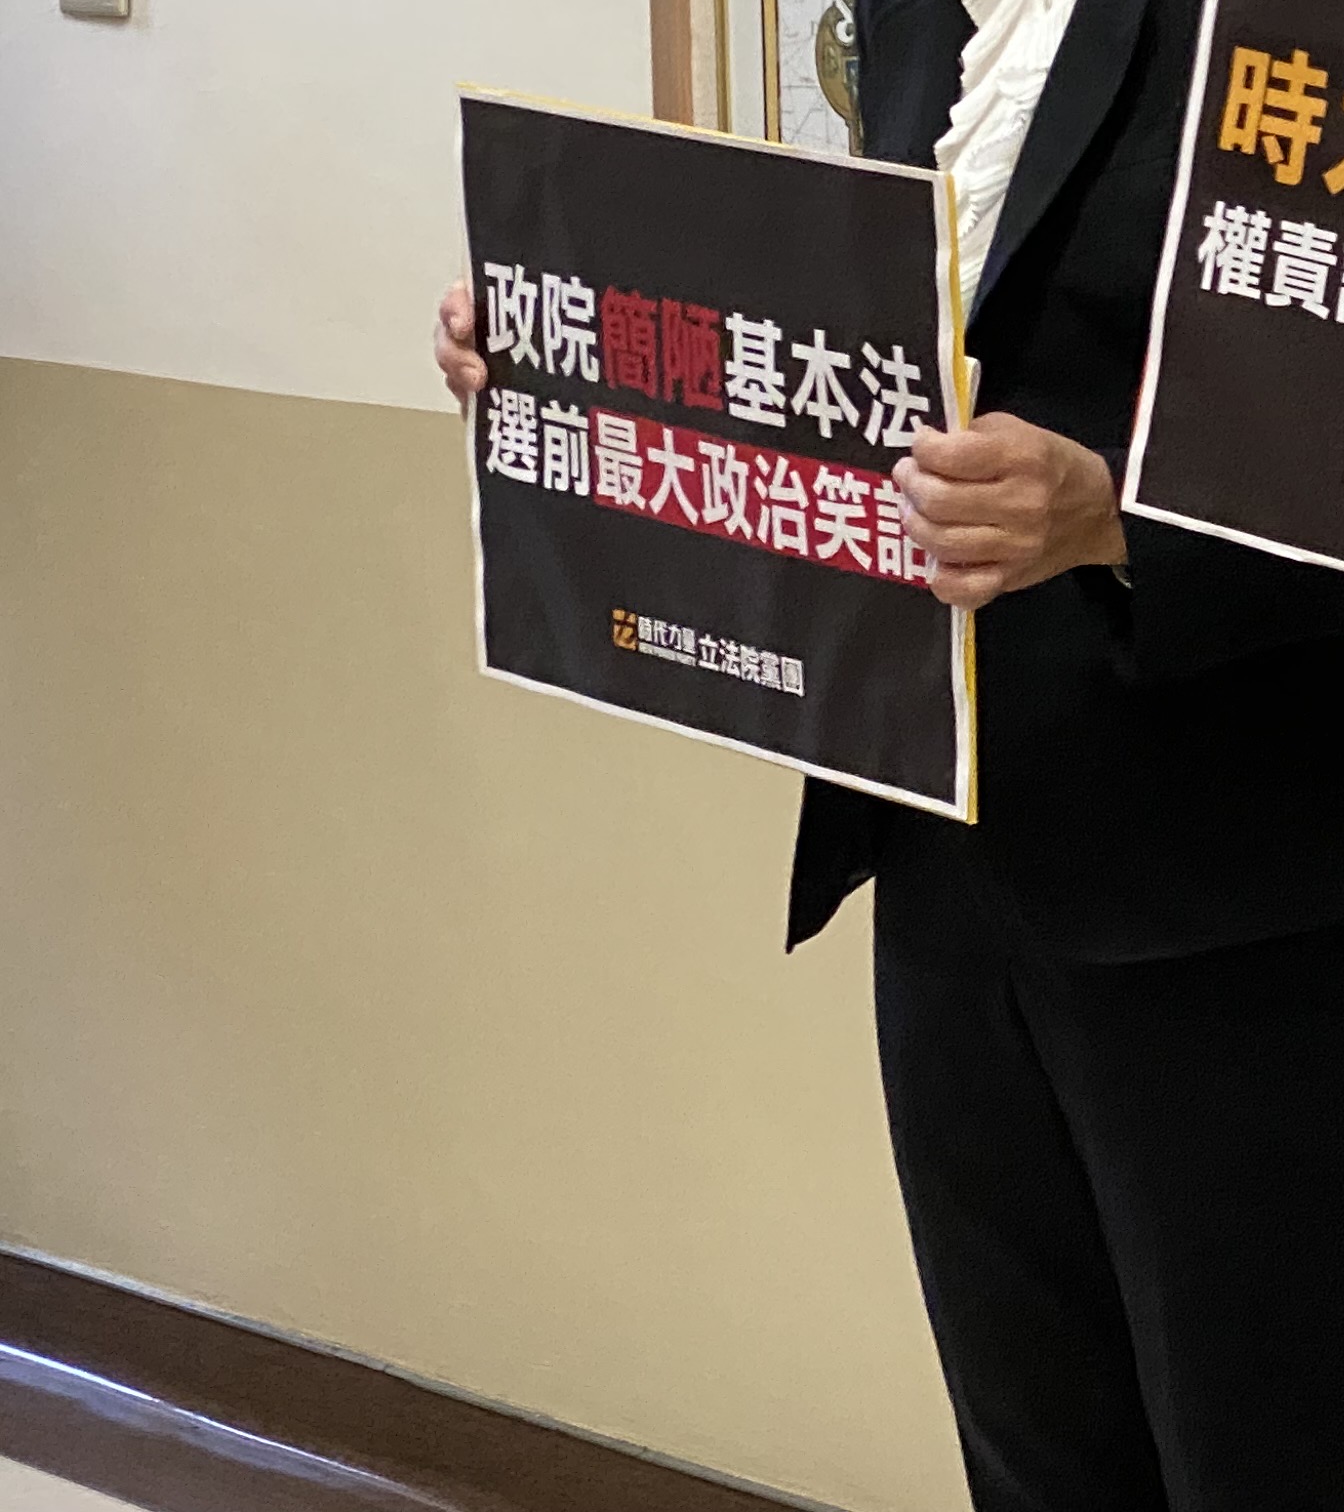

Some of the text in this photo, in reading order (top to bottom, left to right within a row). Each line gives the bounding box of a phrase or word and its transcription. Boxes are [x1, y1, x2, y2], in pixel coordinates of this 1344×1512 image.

[483, 261, 931, 450] 政院簡陋基本法
